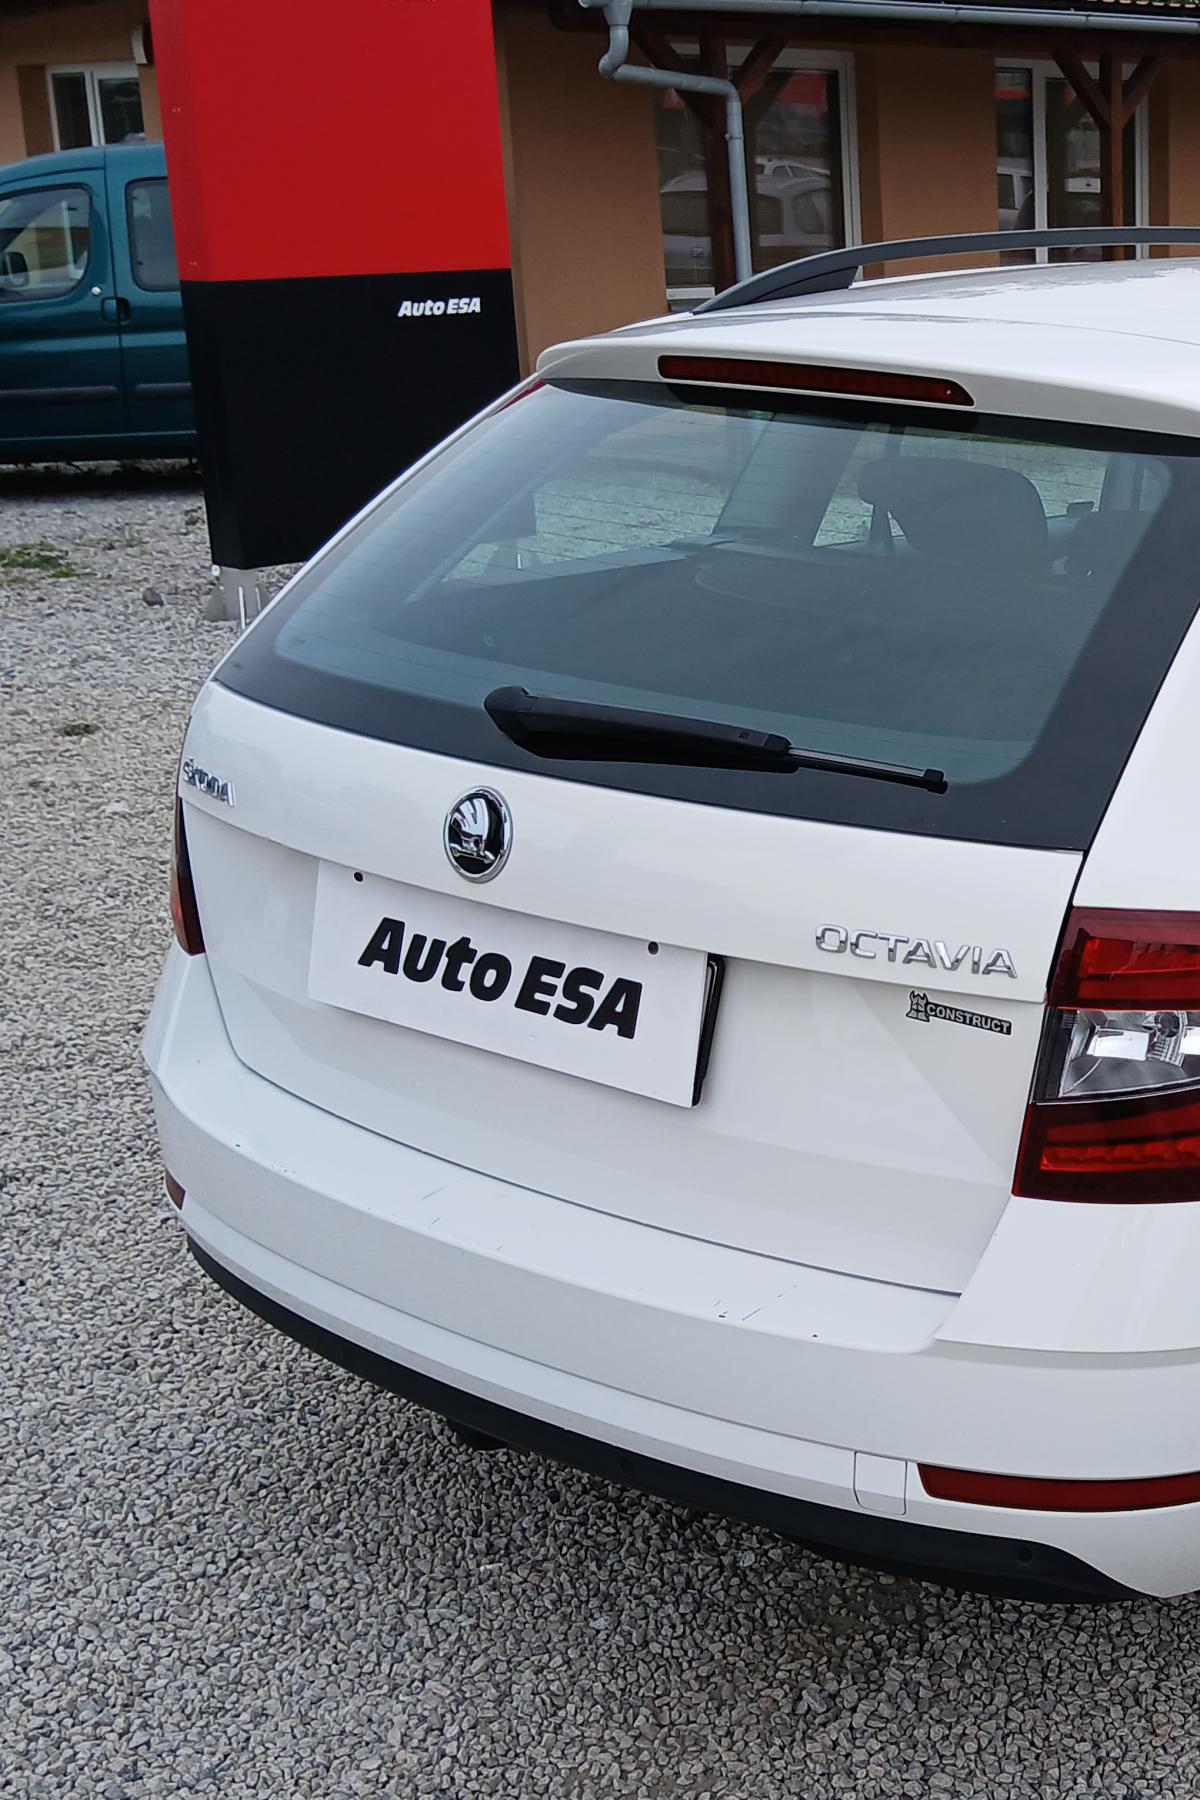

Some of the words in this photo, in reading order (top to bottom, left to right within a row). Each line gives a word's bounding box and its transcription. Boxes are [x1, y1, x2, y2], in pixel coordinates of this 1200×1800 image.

[397, 299, 445, 317] Auto
[446, 297, 481, 315] ESA
[815, 923, 1018, 979] OCTAVIA
[357, 917, 512, 1002] Auto
[514, 955, 643, 1040] ESA
[926, 1003, 1010, 1034] CONSTRUCT
